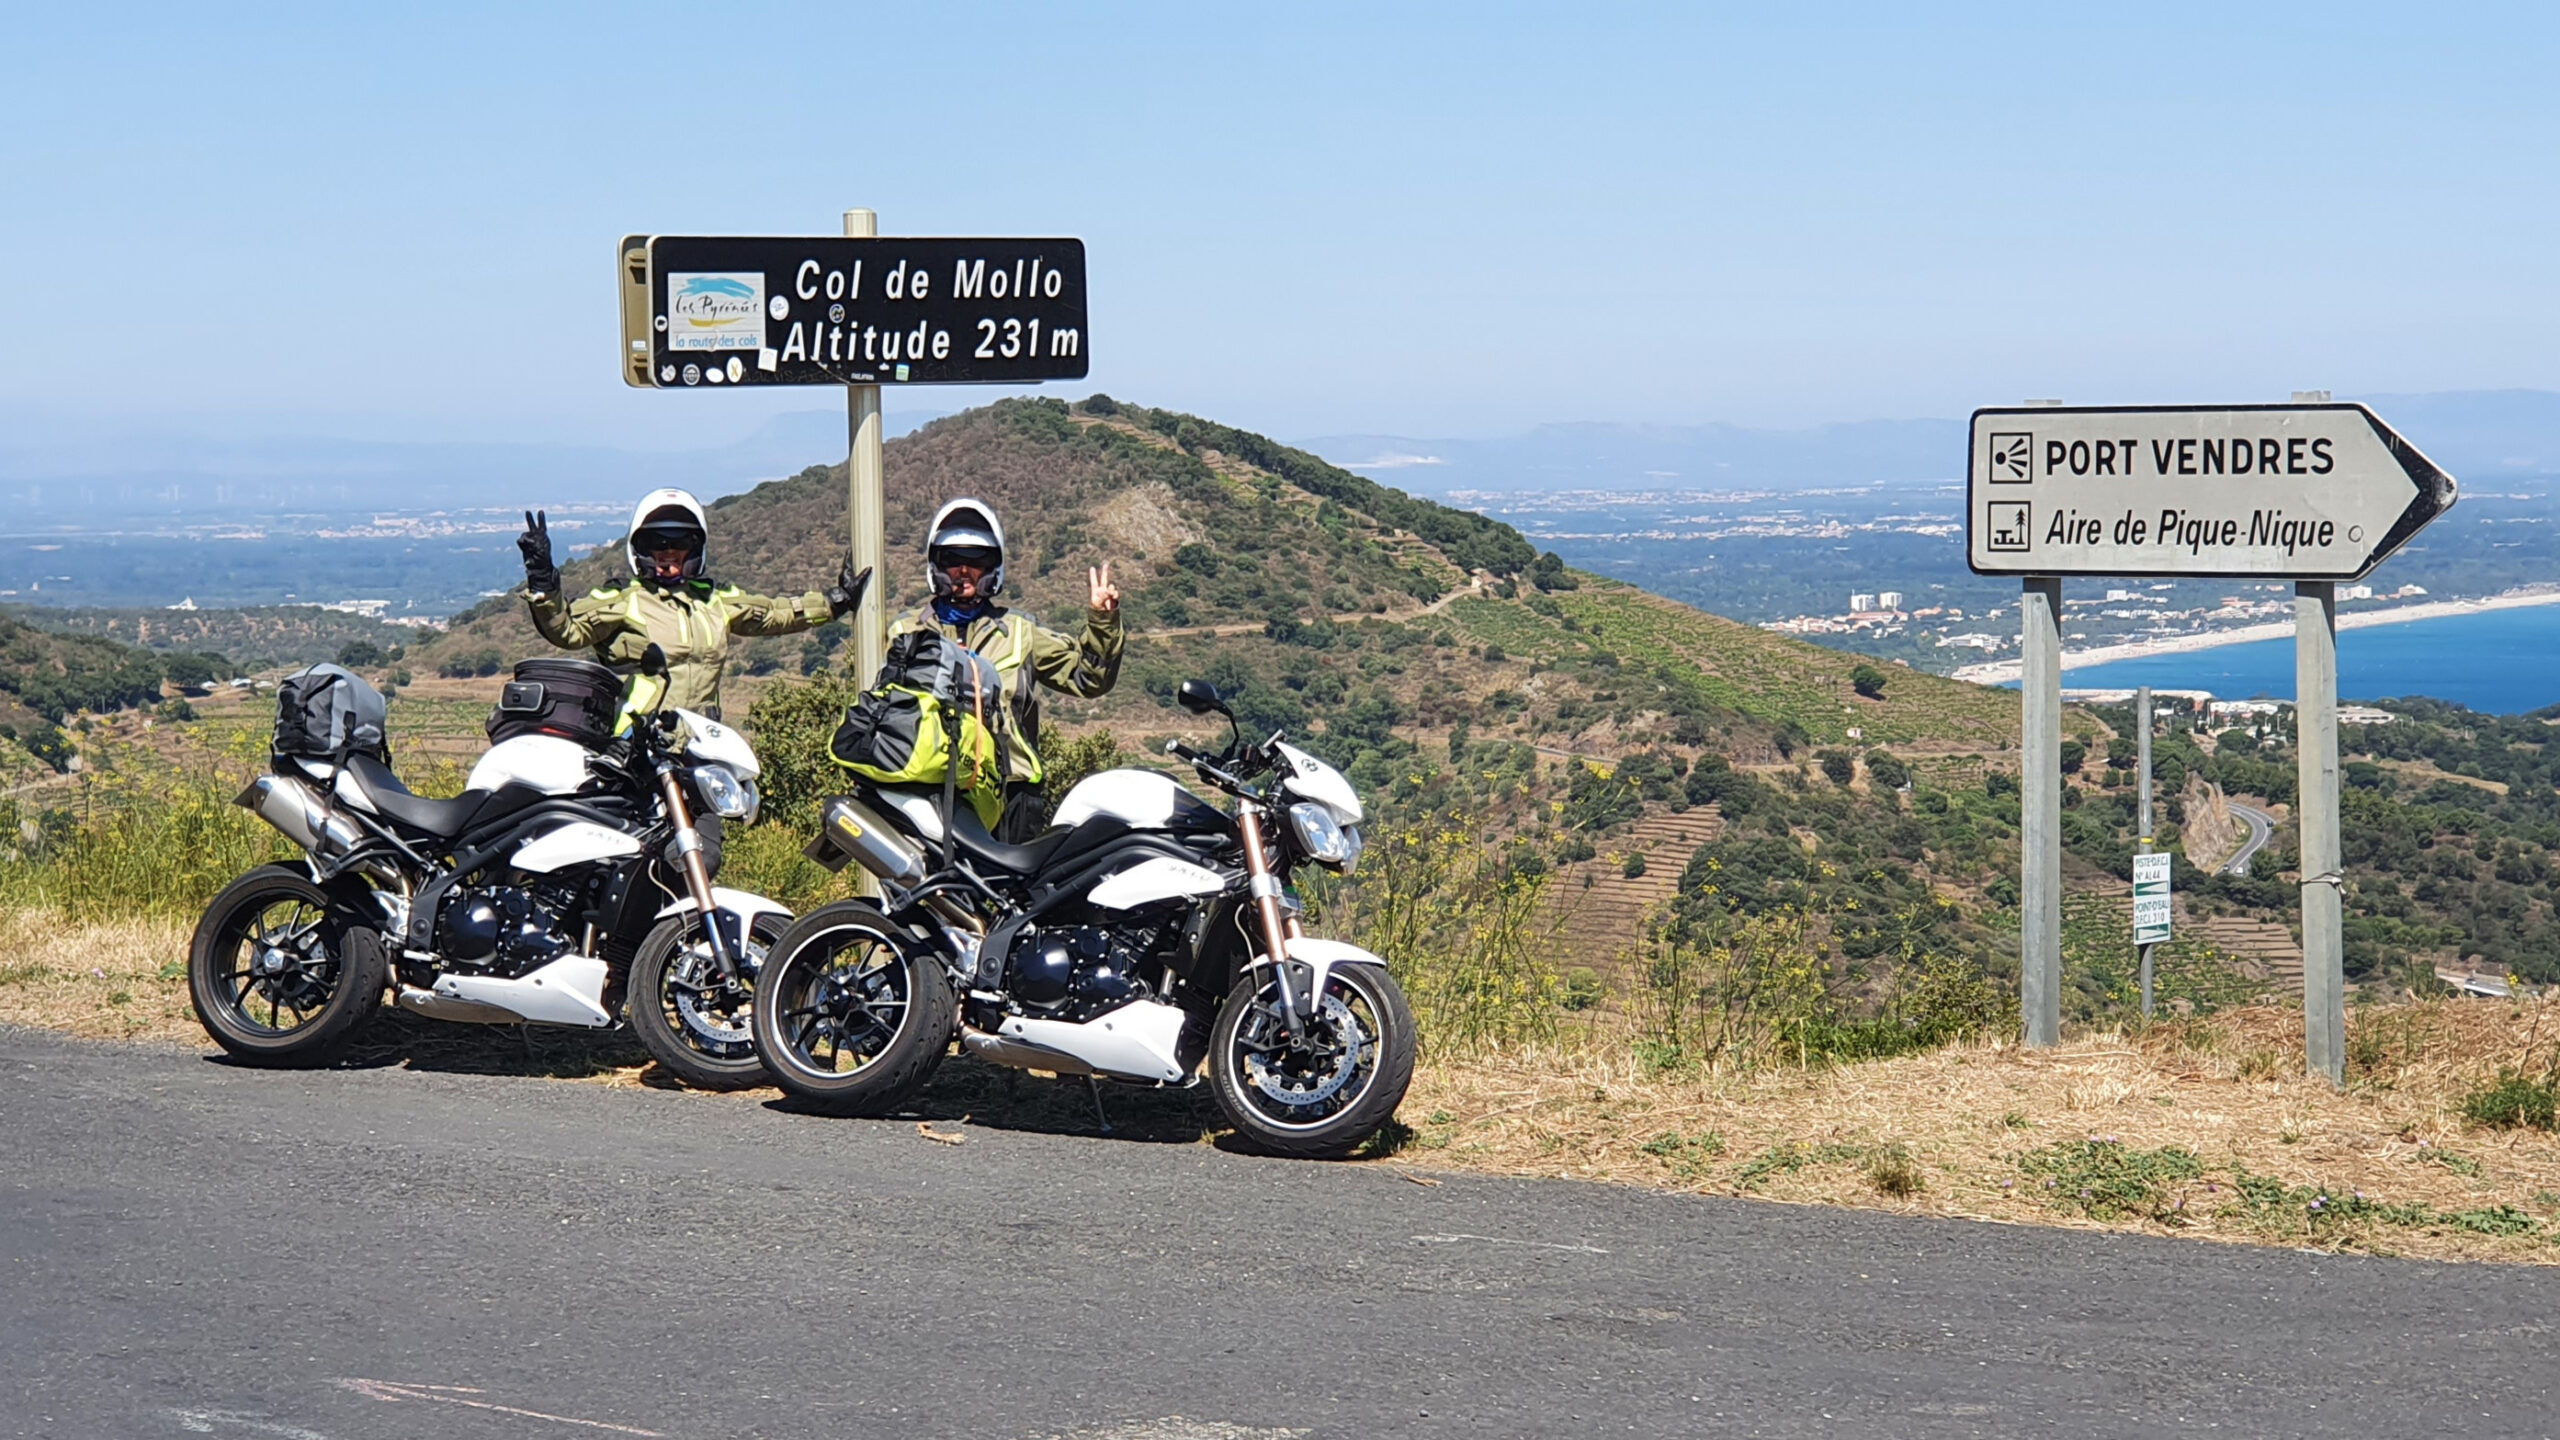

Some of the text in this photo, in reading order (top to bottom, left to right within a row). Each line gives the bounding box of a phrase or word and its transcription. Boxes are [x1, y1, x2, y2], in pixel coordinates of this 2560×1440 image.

[796, 259, 1062, 300] Col de Mollo
[718, 333, 735, 347] des
[738, 333, 757, 347] cols
[781, 318, 1079, 362] Altitude 231 m
[2046, 437, 2334, 476] PORT VENDRES
[2045, 508, 2334, 557] Aire de Pique-Nique
